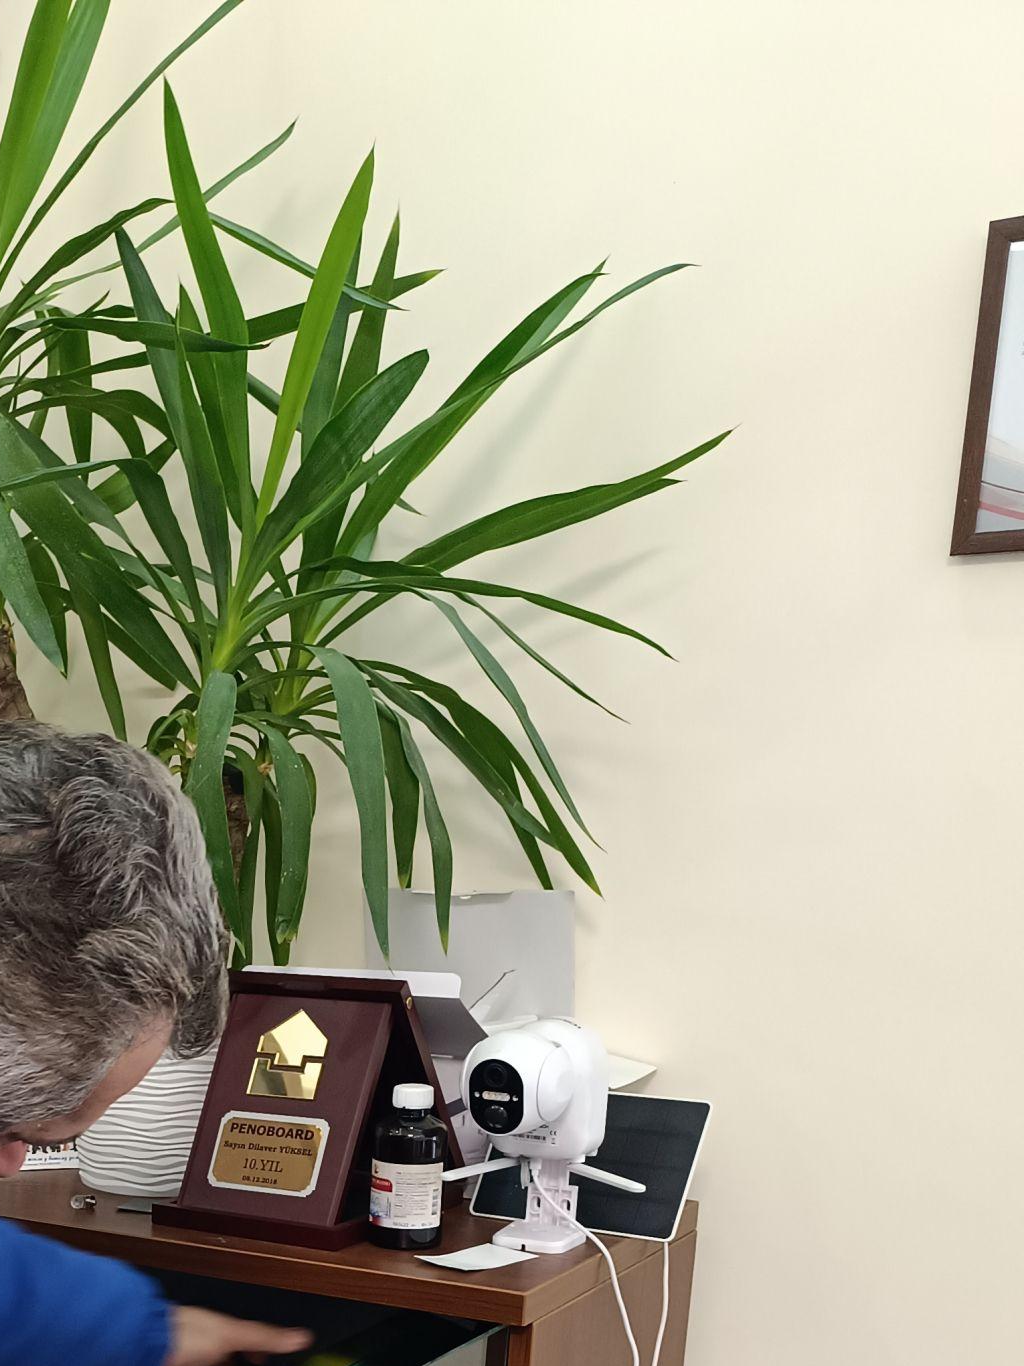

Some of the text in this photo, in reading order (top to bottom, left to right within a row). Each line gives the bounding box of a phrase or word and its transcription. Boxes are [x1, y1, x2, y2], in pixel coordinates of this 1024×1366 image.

[230, 1122, 314, 1140] PENOBOARD
[248, 1143, 277, 1153] Dilaver
[279, 1145, 313, 1156] YÜKSEL
[243, 1158, 283, 1173] 10.YIL
